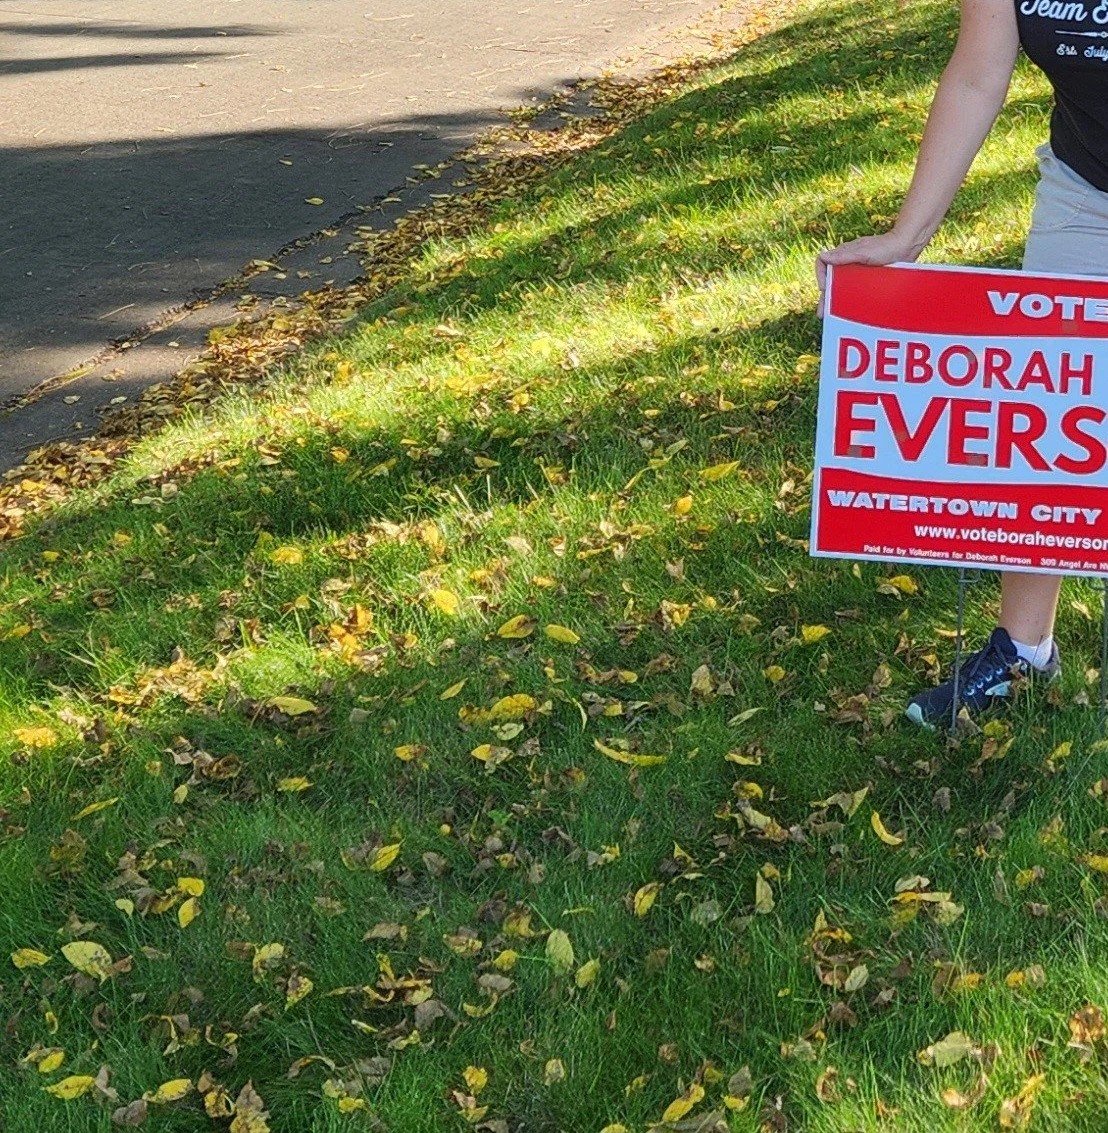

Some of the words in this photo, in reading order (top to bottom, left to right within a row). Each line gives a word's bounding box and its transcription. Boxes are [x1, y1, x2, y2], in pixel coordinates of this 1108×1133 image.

[837, 337, 1094, 396] DEBORAH
[827, 489, 1018, 520] WATERTOWN
[1031, 504, 1102, 525] CITY
[863, 544, 881, 553] Paid
[883, 546, 894, 554] for
[897, 547, 906, 556] by
[909, 548, 950, 559] Volunteers
[952, 551, 963, 559] for
[966, 552, 998, 562] Deborah
[1000, 555, 1032, 565] Everson
[1059, 559, 1081, 569] Angel
